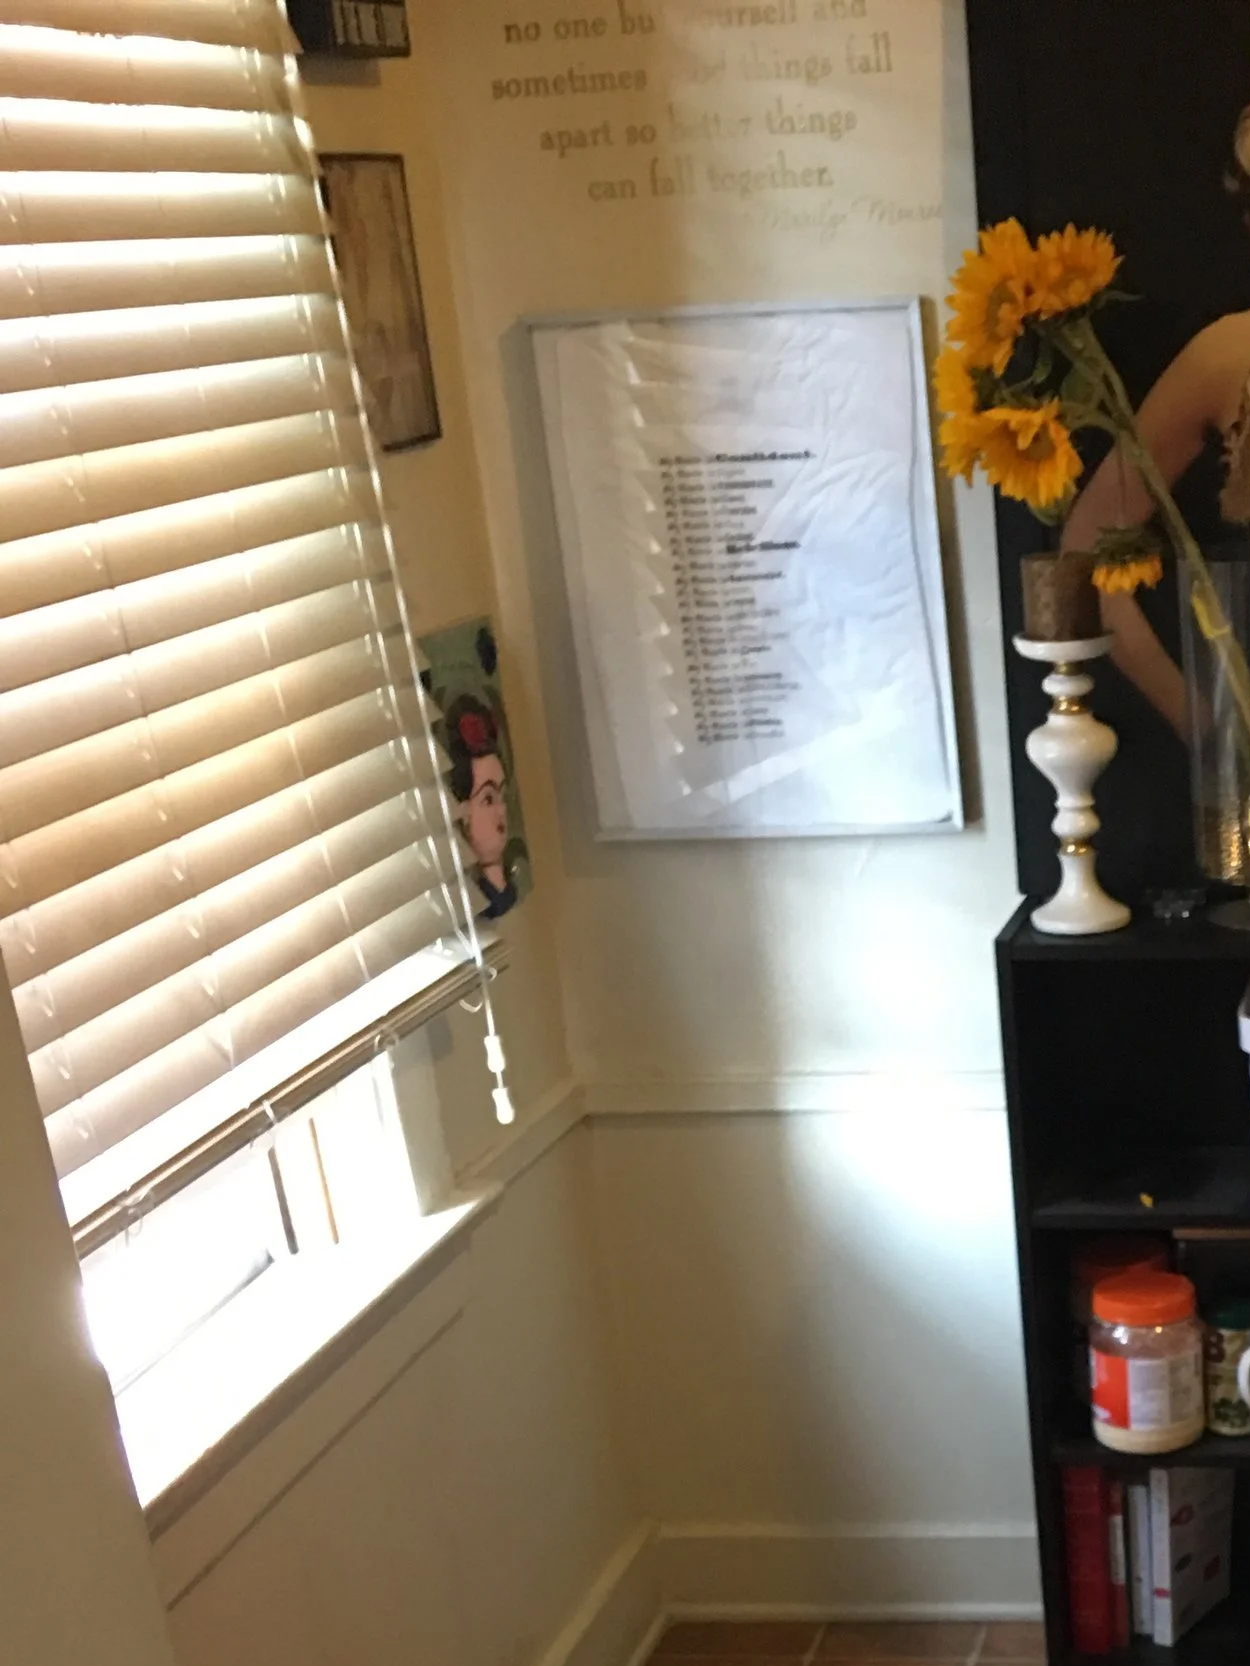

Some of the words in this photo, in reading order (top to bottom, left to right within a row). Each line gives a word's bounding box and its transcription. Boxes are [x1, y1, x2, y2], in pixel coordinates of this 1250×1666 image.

[504, 20, 541, 44] no
[553, 16, 608, 40] one
[616, 0, 658, 36] bu
[490, 61, 649, 101] sometimes
[540, 119, 614, 160] apart
[625, 124, 657, 147] so
[766, 95, 858, 142] things
[588, 178, 639, 202] can
[650, 155, 698, 198] fall
